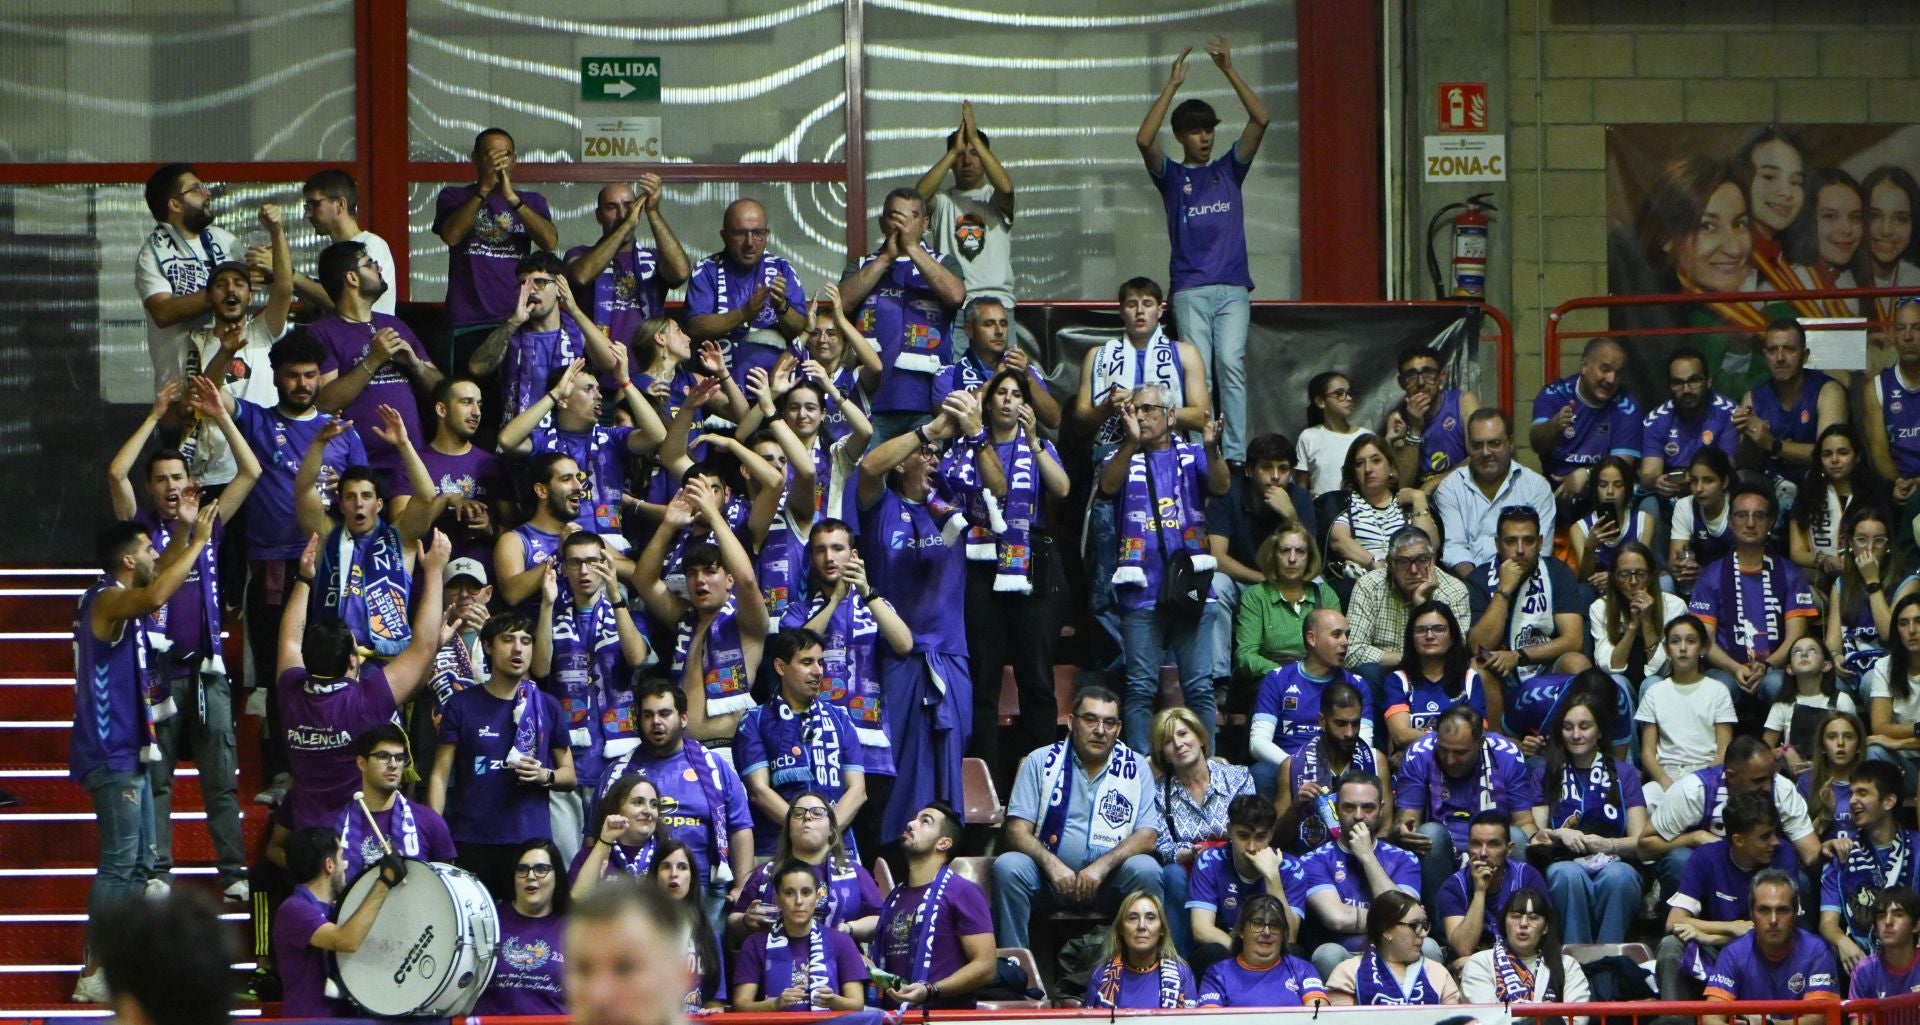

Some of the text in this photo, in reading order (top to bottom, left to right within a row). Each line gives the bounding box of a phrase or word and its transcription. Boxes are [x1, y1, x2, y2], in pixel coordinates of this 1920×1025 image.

[587, 62, 658, 77] SALIDA
[584, 136, 658, 157] ZONA-C
[1427, 155, 1502, 176] ZONA-C
[1187, 200, 1231, 217] zunder
[287, 729, 352, 746] PALENCIA
